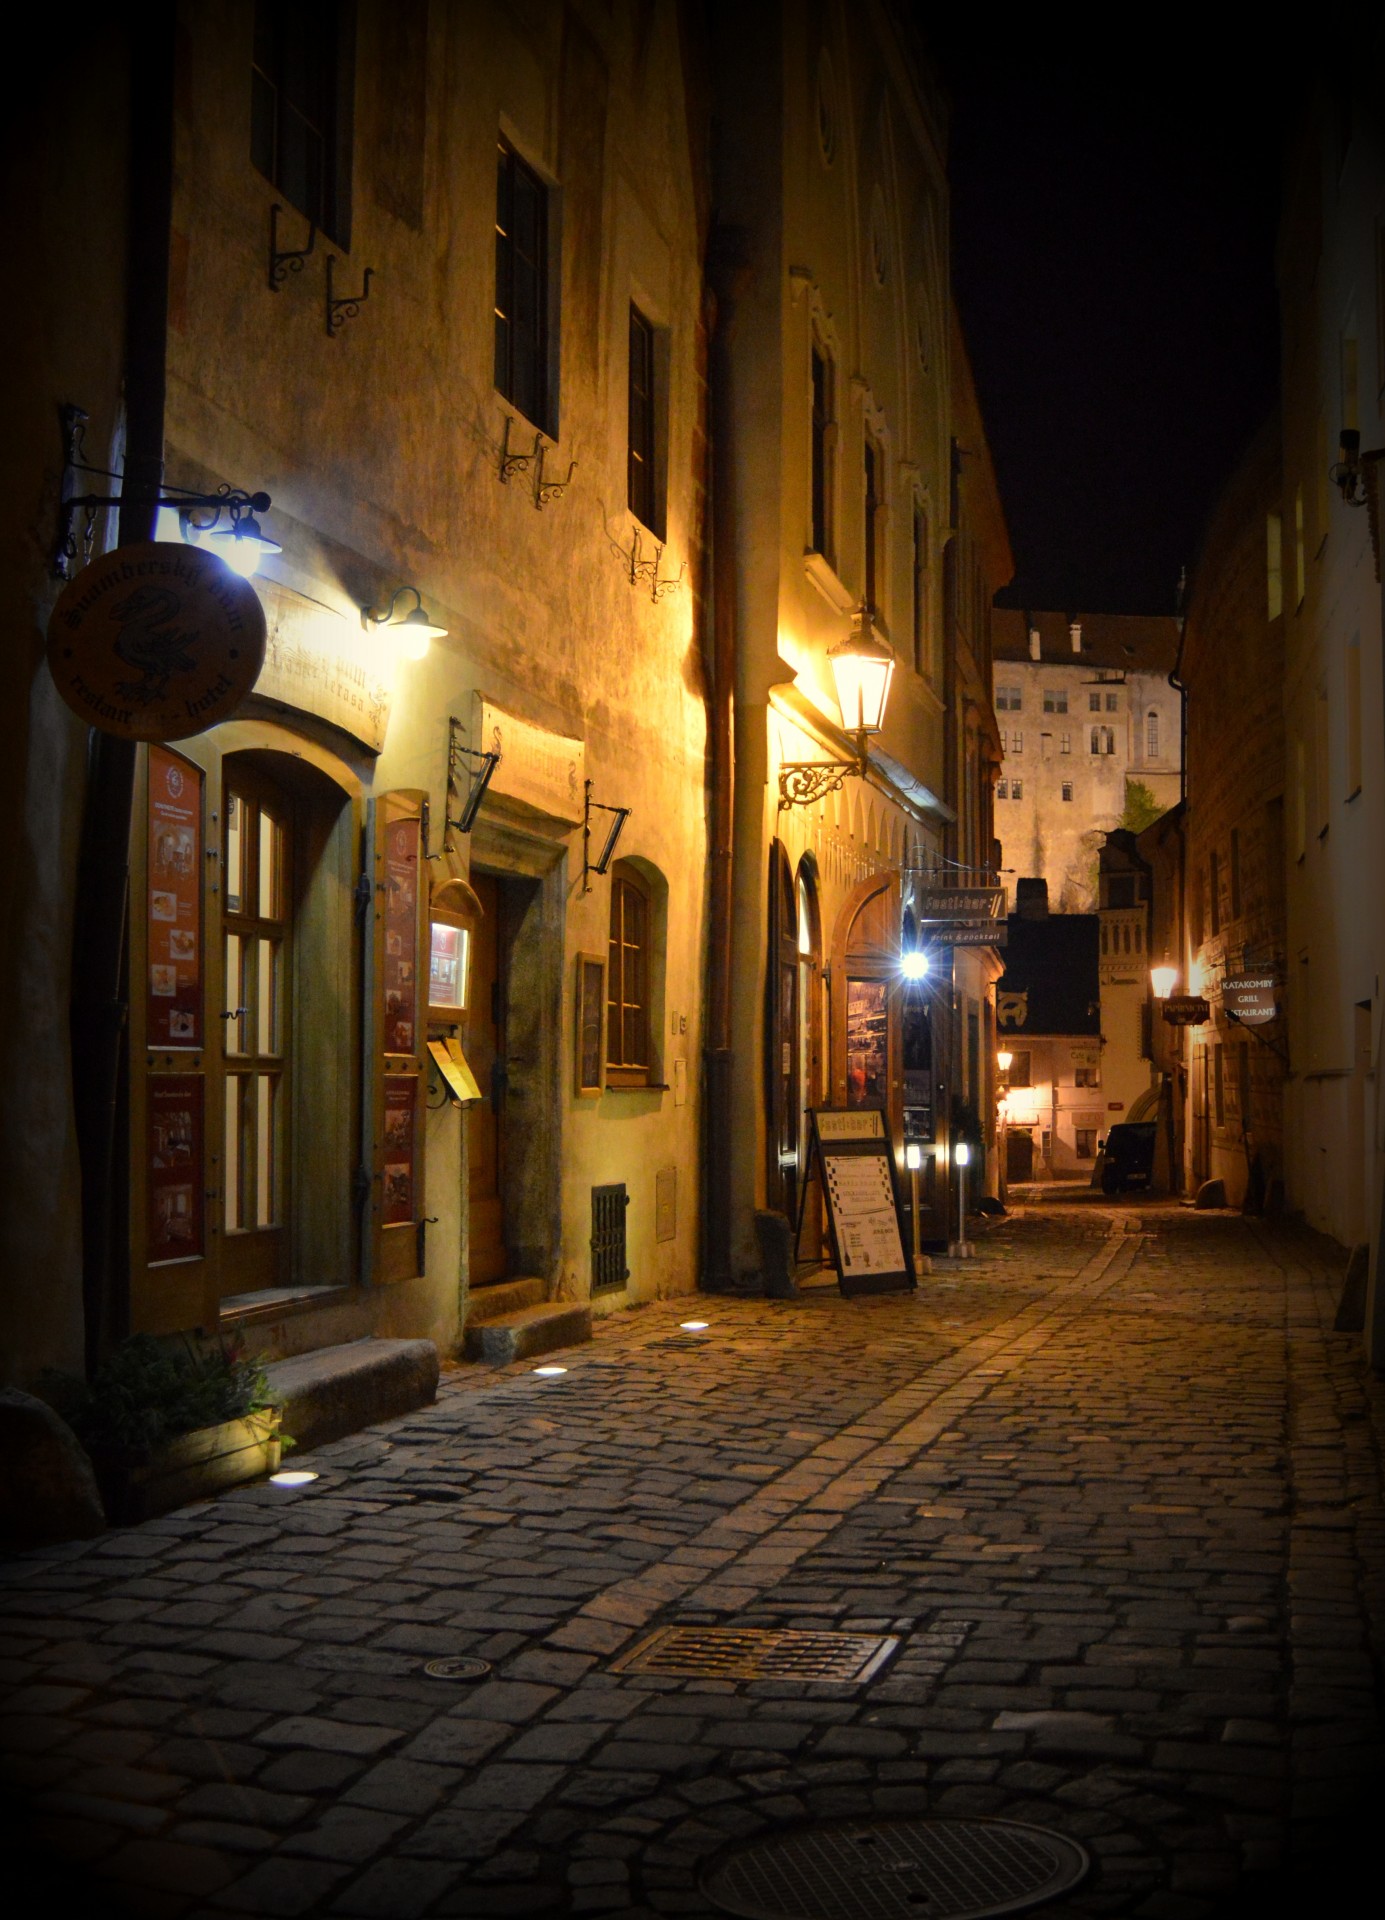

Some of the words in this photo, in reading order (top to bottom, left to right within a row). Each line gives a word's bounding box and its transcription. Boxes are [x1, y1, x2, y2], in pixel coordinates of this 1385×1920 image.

[931, 933, 953, 941] drink
[1222, 980, 1273, 989] KATAKOMBY
[1237, 995, 1259, 1003] GRILL
[1224, 1008, 1274, 1018] STAURANT
